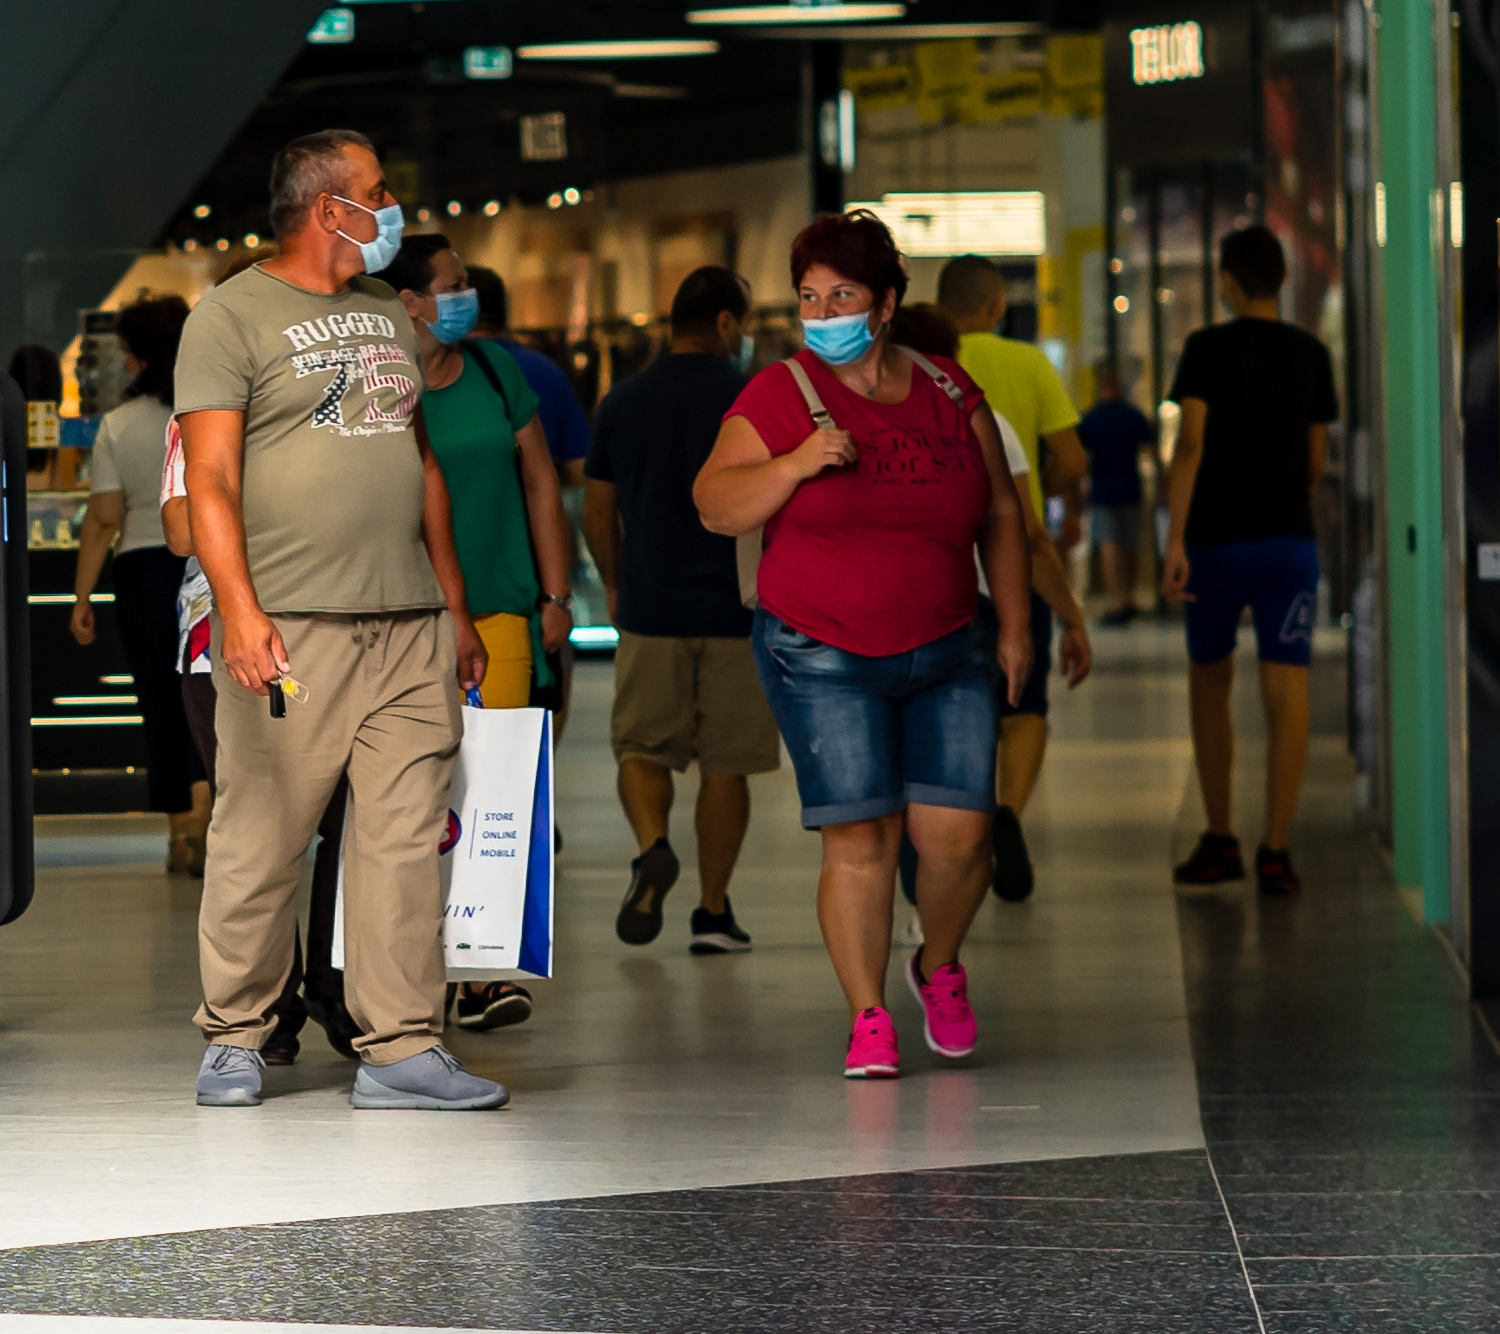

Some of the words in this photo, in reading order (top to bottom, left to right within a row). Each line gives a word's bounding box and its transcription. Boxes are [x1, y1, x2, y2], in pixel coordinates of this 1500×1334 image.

[282, 312, 396, 352] RUGGED
[291, 348, 356, 369] VINTAGE
[484, 812, 515, 821] STORE
[482, 830, 518, 840] ONLINE
[480, 848, 516, 857] MOBILE
